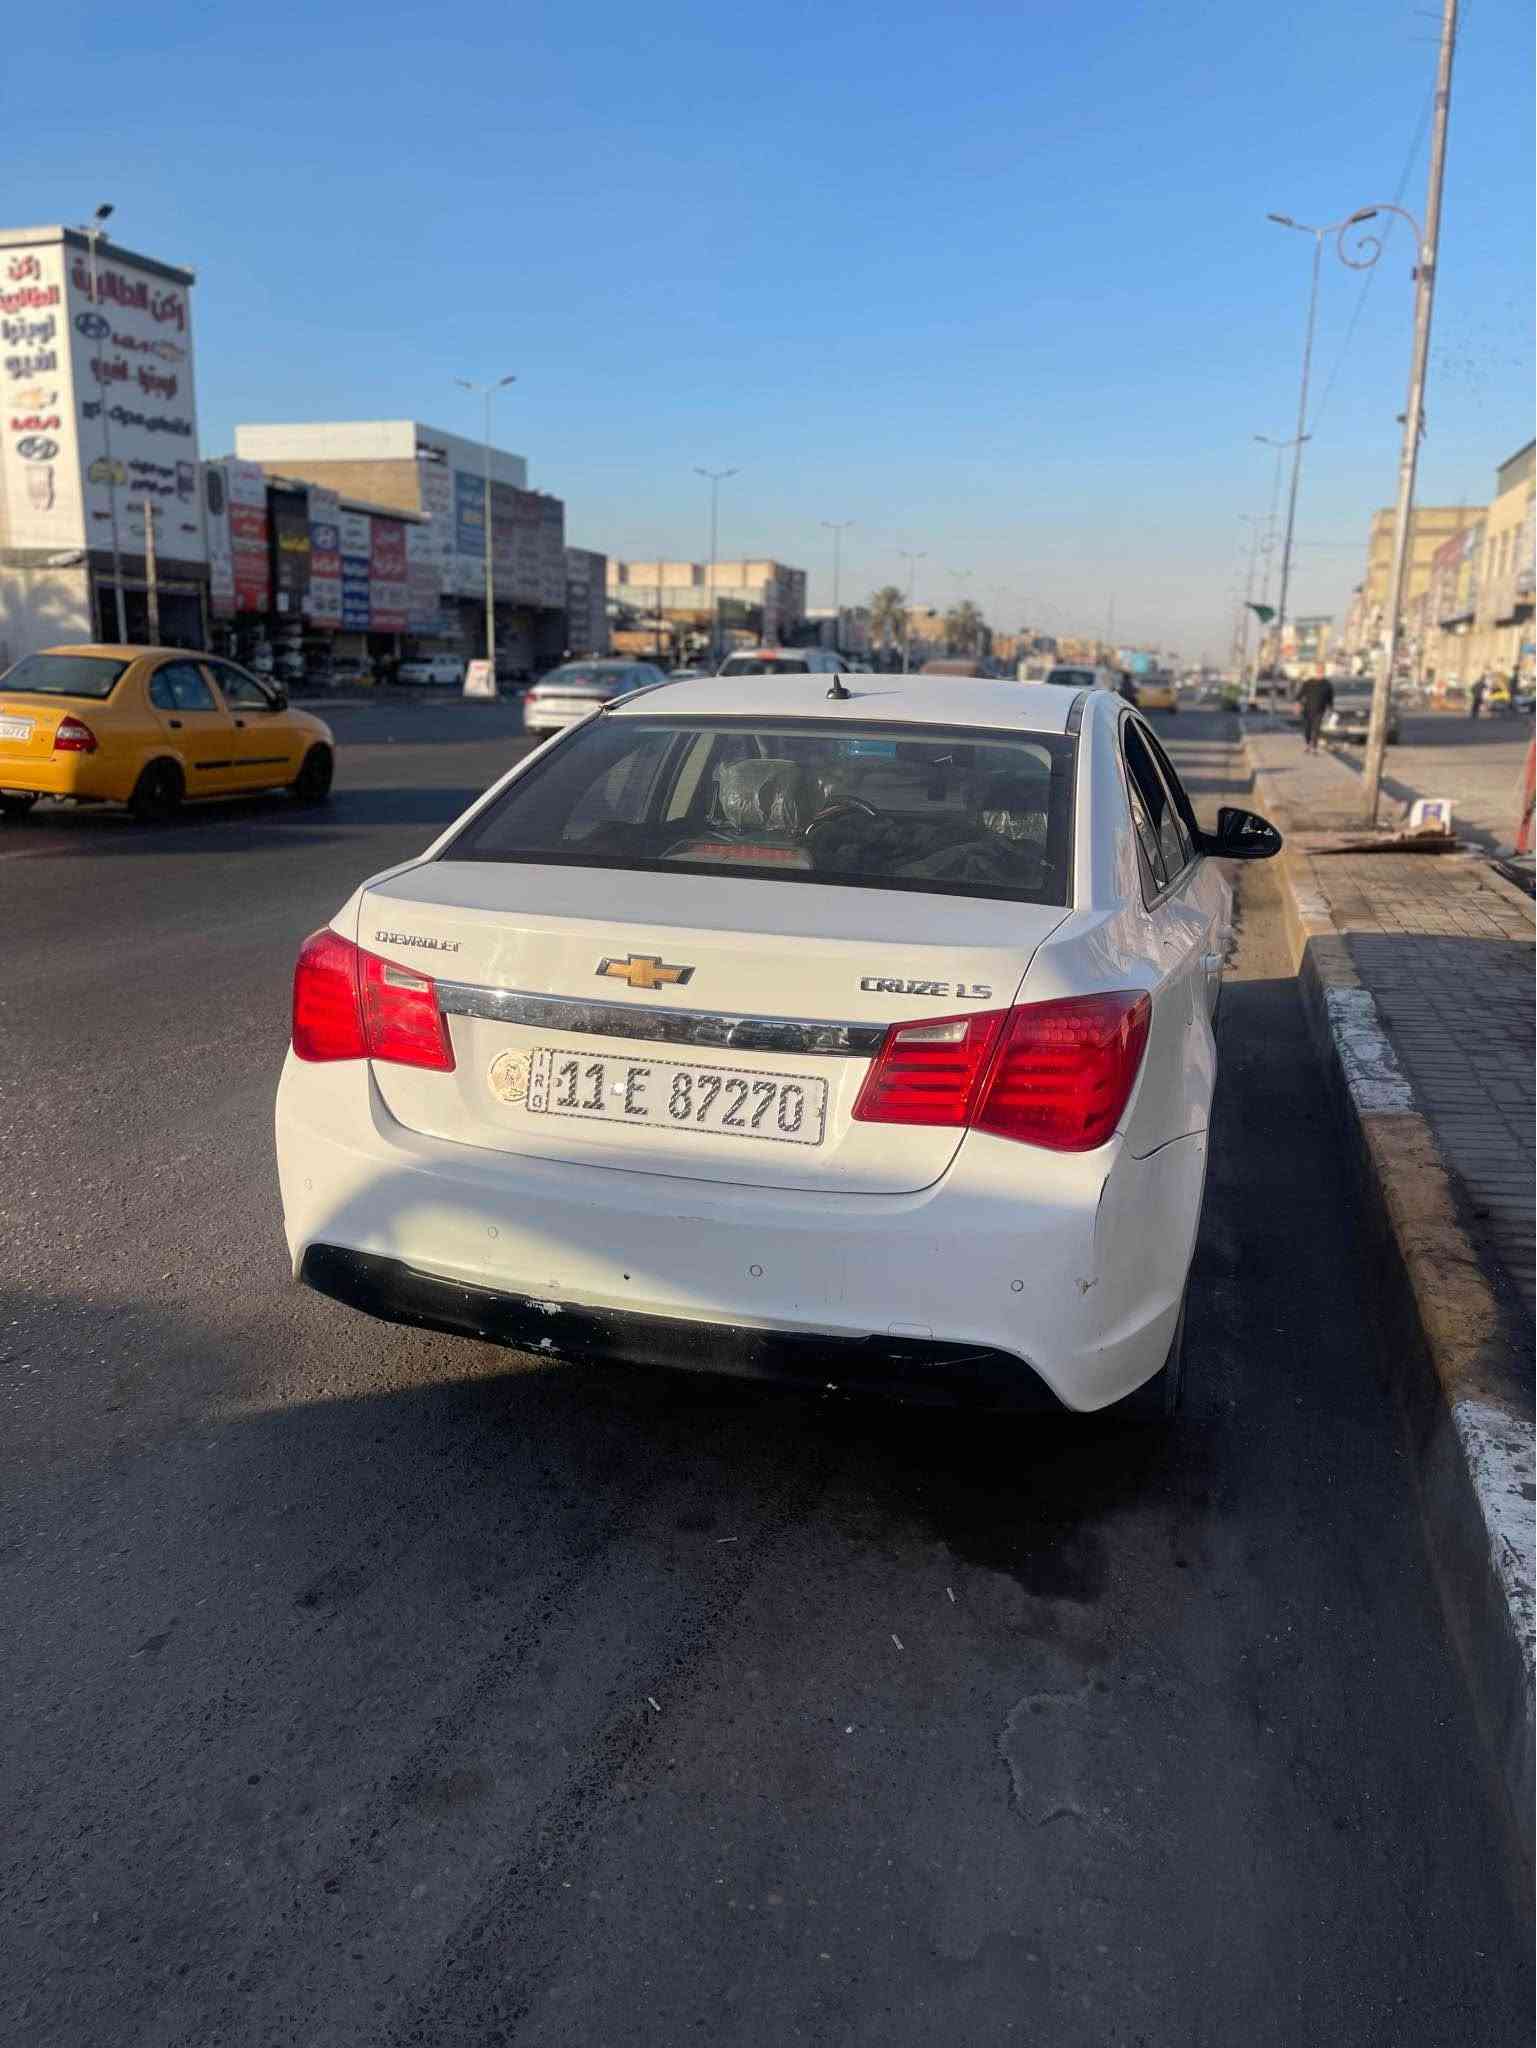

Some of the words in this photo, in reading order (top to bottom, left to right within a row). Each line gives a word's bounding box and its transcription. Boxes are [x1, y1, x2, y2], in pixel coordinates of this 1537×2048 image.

[860, 977, 949, 997] CRUZE
[955, 984, 992, 999] LS
[557, 1060, 605, 1110] 11
[624, 1067, 650, 1115] E
[668, 1071, 804, 1132] 87270
